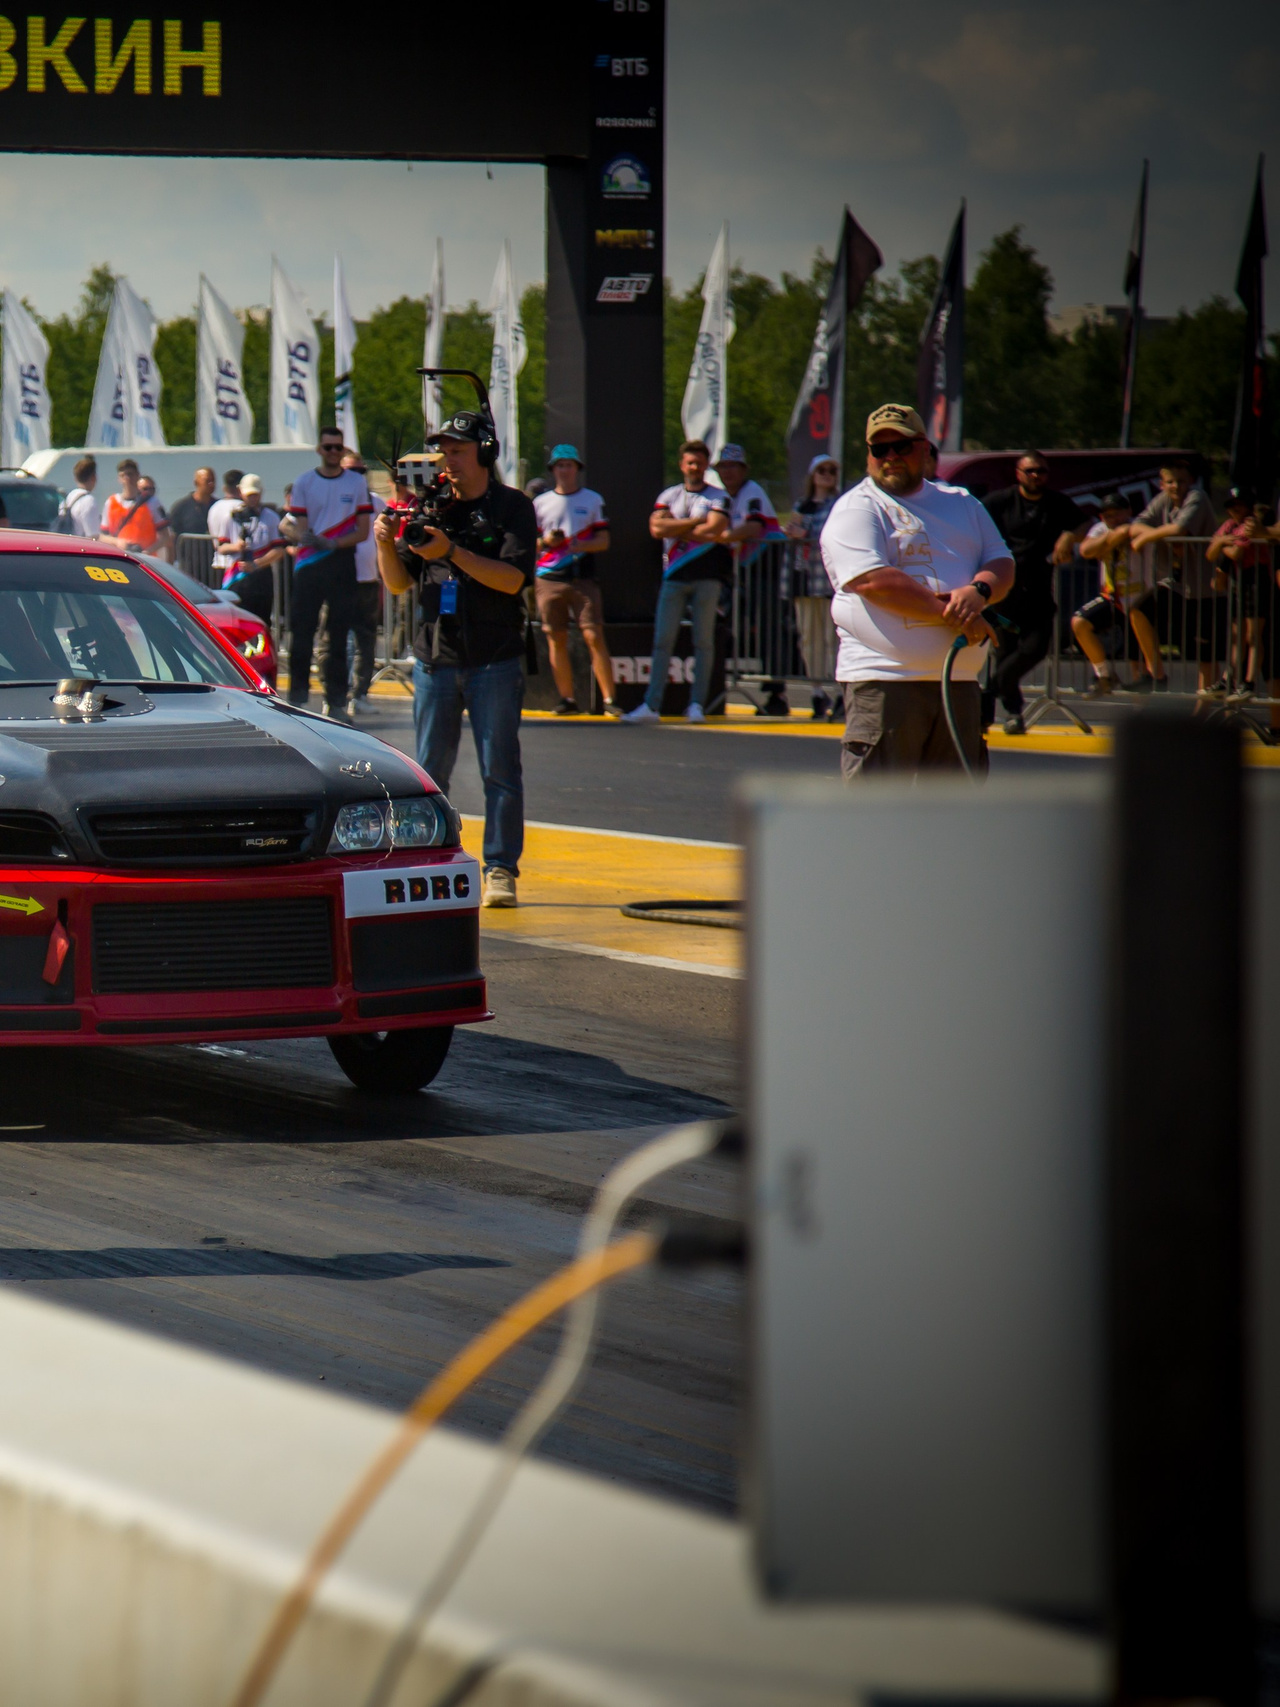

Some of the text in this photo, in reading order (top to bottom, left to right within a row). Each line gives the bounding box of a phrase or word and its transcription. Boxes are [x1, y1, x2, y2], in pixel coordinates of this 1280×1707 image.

[612, 57, 650, 76] ВТБ
[603, 279, 647, 292] АВТО
[21, 363, 41, 418] ВТБ
[216, 356, 240, 421] ВТБ
[287, 339, 310, 404] ВТБ
[383, 873, 469, 905] RDRC
